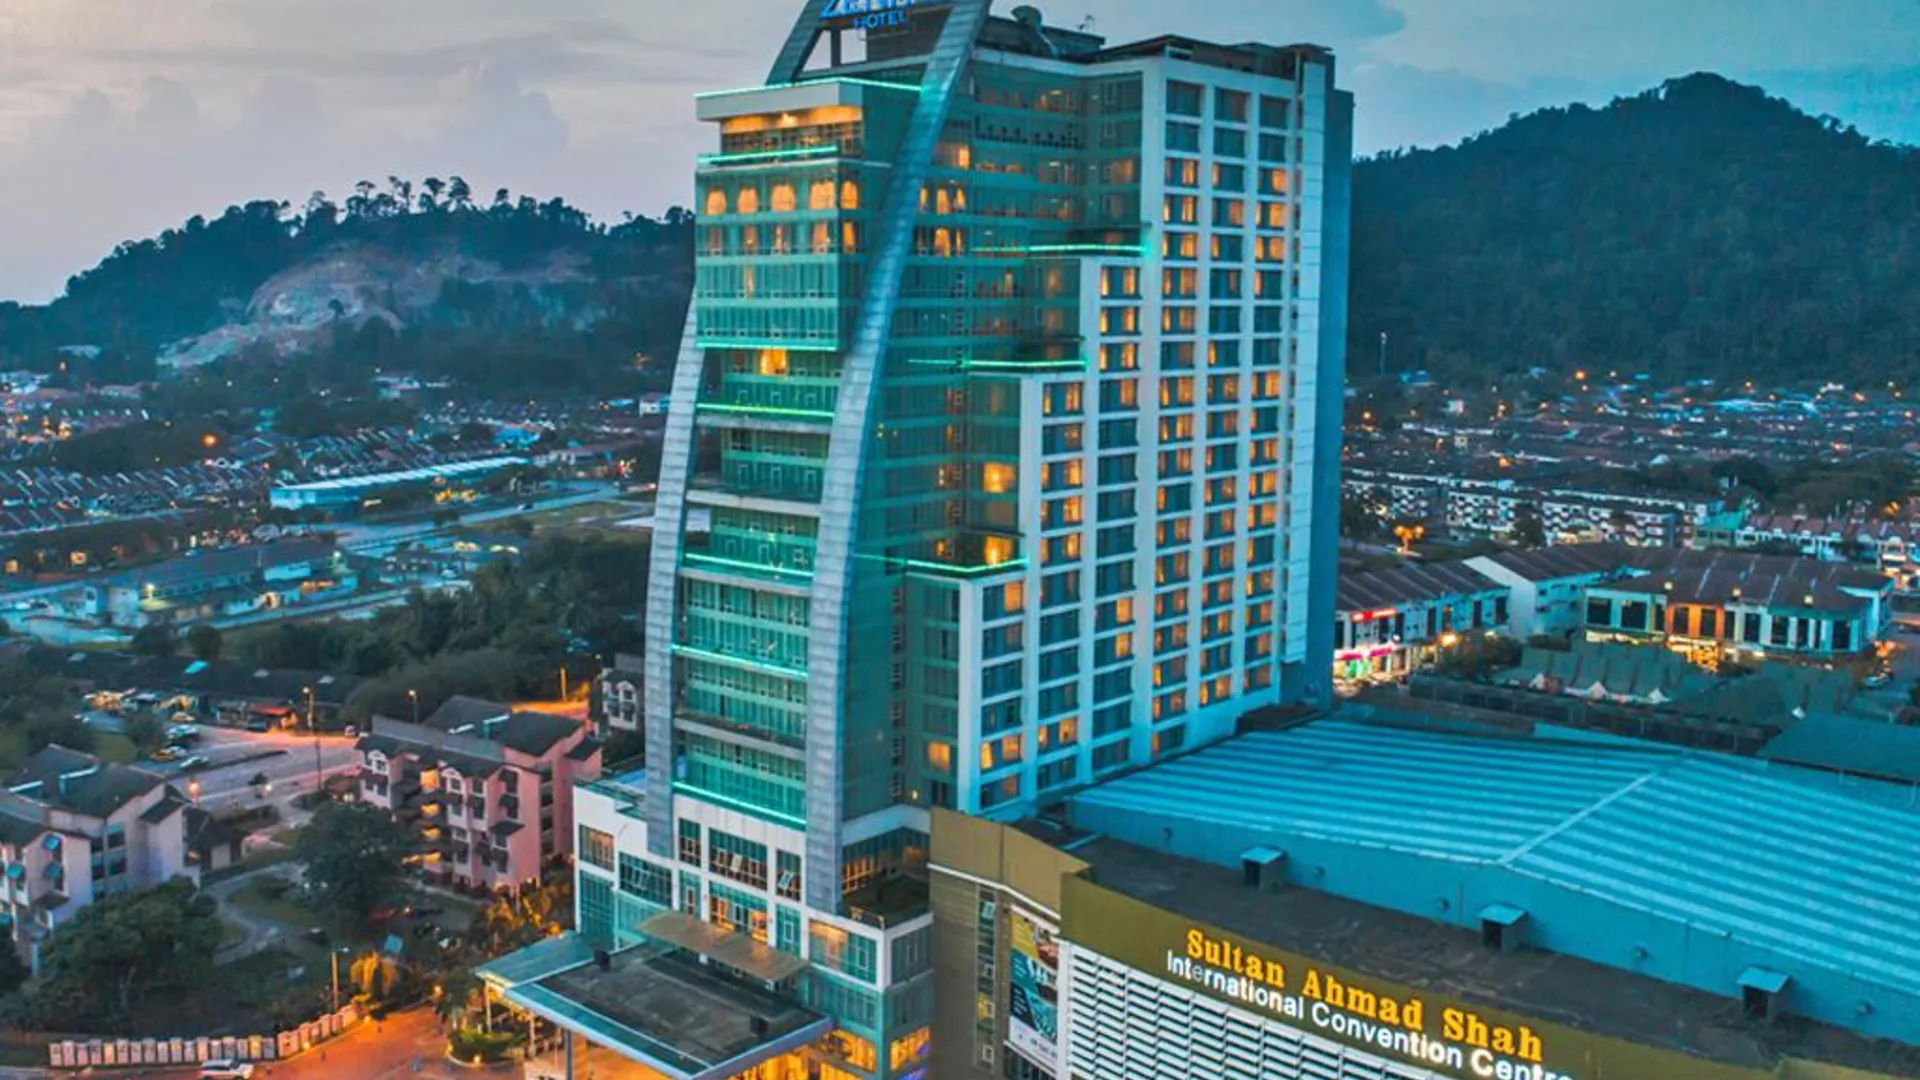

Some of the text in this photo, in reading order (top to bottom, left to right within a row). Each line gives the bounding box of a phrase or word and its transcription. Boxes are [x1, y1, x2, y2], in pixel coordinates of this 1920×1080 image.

[854, 11, 906, 29] HOTEL
[1167, 949, 1574, 1080] International Convention Cent
[1187, 929, 1542, 1061] Sultan Ahmad Shah
